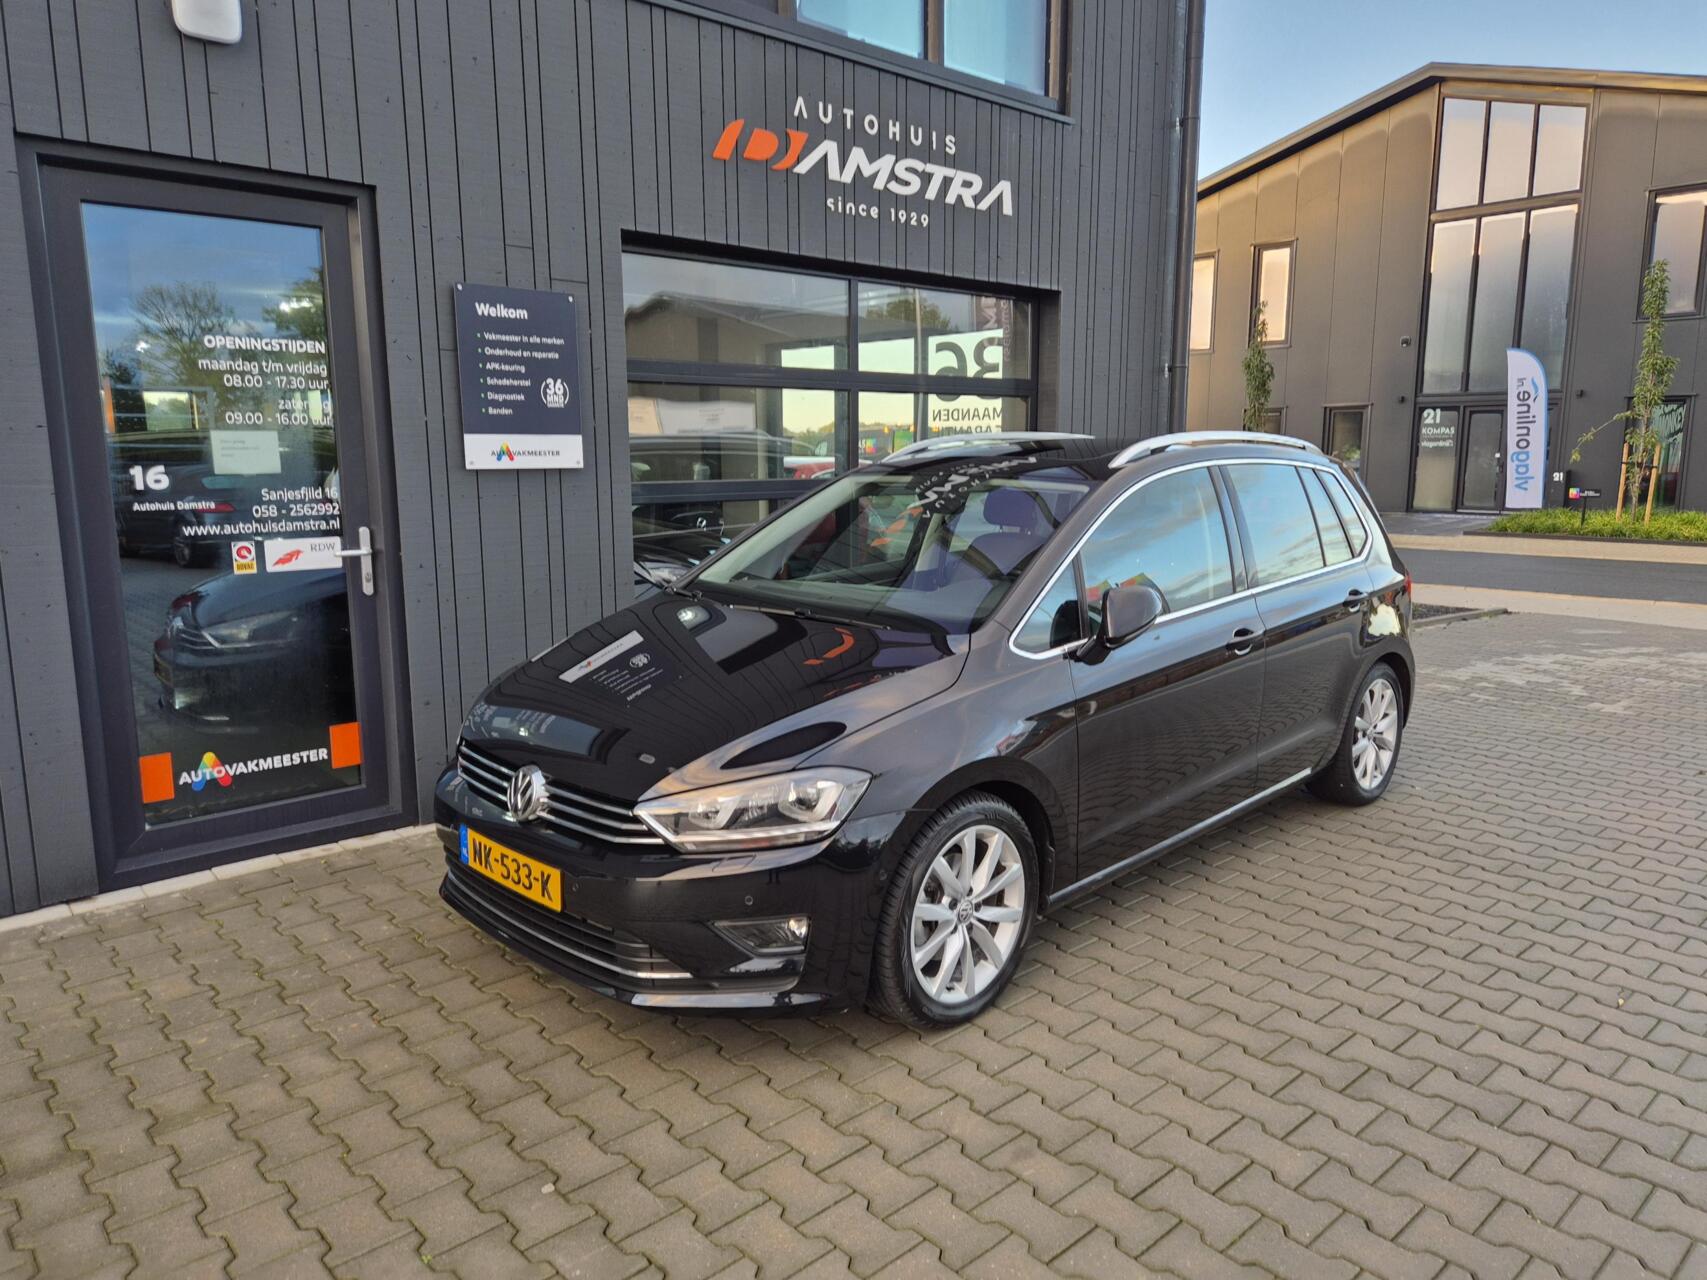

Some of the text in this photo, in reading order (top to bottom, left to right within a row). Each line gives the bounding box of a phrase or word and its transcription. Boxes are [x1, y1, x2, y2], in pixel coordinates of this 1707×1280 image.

[794, 95, 956, 155] AUTOHUIS
[827, 196, 929, 227] since 1929
[475, 301, 528, 320] Welkom
[203, 334, 326, 355] OPENINGSTIJDEN
[484, 331, 521, 342] Vakmeester
[529, 335, 540, 344] alle
[541, 337, 565, 345] merken
[484, 346, 522, 357] Onderhoud
[532, 351, 559, 360] reparatie
[198, 358, 328, 378] maandag t/m vrijdag
[486, 362, 525, 373] APK-keuring
[223, 373, 263, 387] 08.00
[275, 376, 306, 389] 17.30
[308, 379, 329, 389] uur
[486, 377, 531, 387] Schadeherstel
[546, 377, 564, 395] 36
[487, 392, 525, 402] Diagnostiek
[225, 411, 263, 425] 09.00
[275, 412, 309, 426] 16.00
[488, 407, 513, 416] Banden
[1423, 408, 1441, 424] 21
[1422, 426, 1455, 435] KOMPAS
[129, 464, 170, 491] 16
[1552, 472, 1564, 482] 21
[325, 486, 338, 500] 16
[132, 500, 216, 512] Autohuis Damstra
[252, 504, 278, 518] 058
[289, 502, 341, 517] 2562992
[181, 518, 341, 537] www.autohuisdamstra.nl
[310, 542, 336, 553] RDW
[178, 747, 329, 786] AUTOVAKMEESTER
[472, 837, 553, 903] NK-533-K
